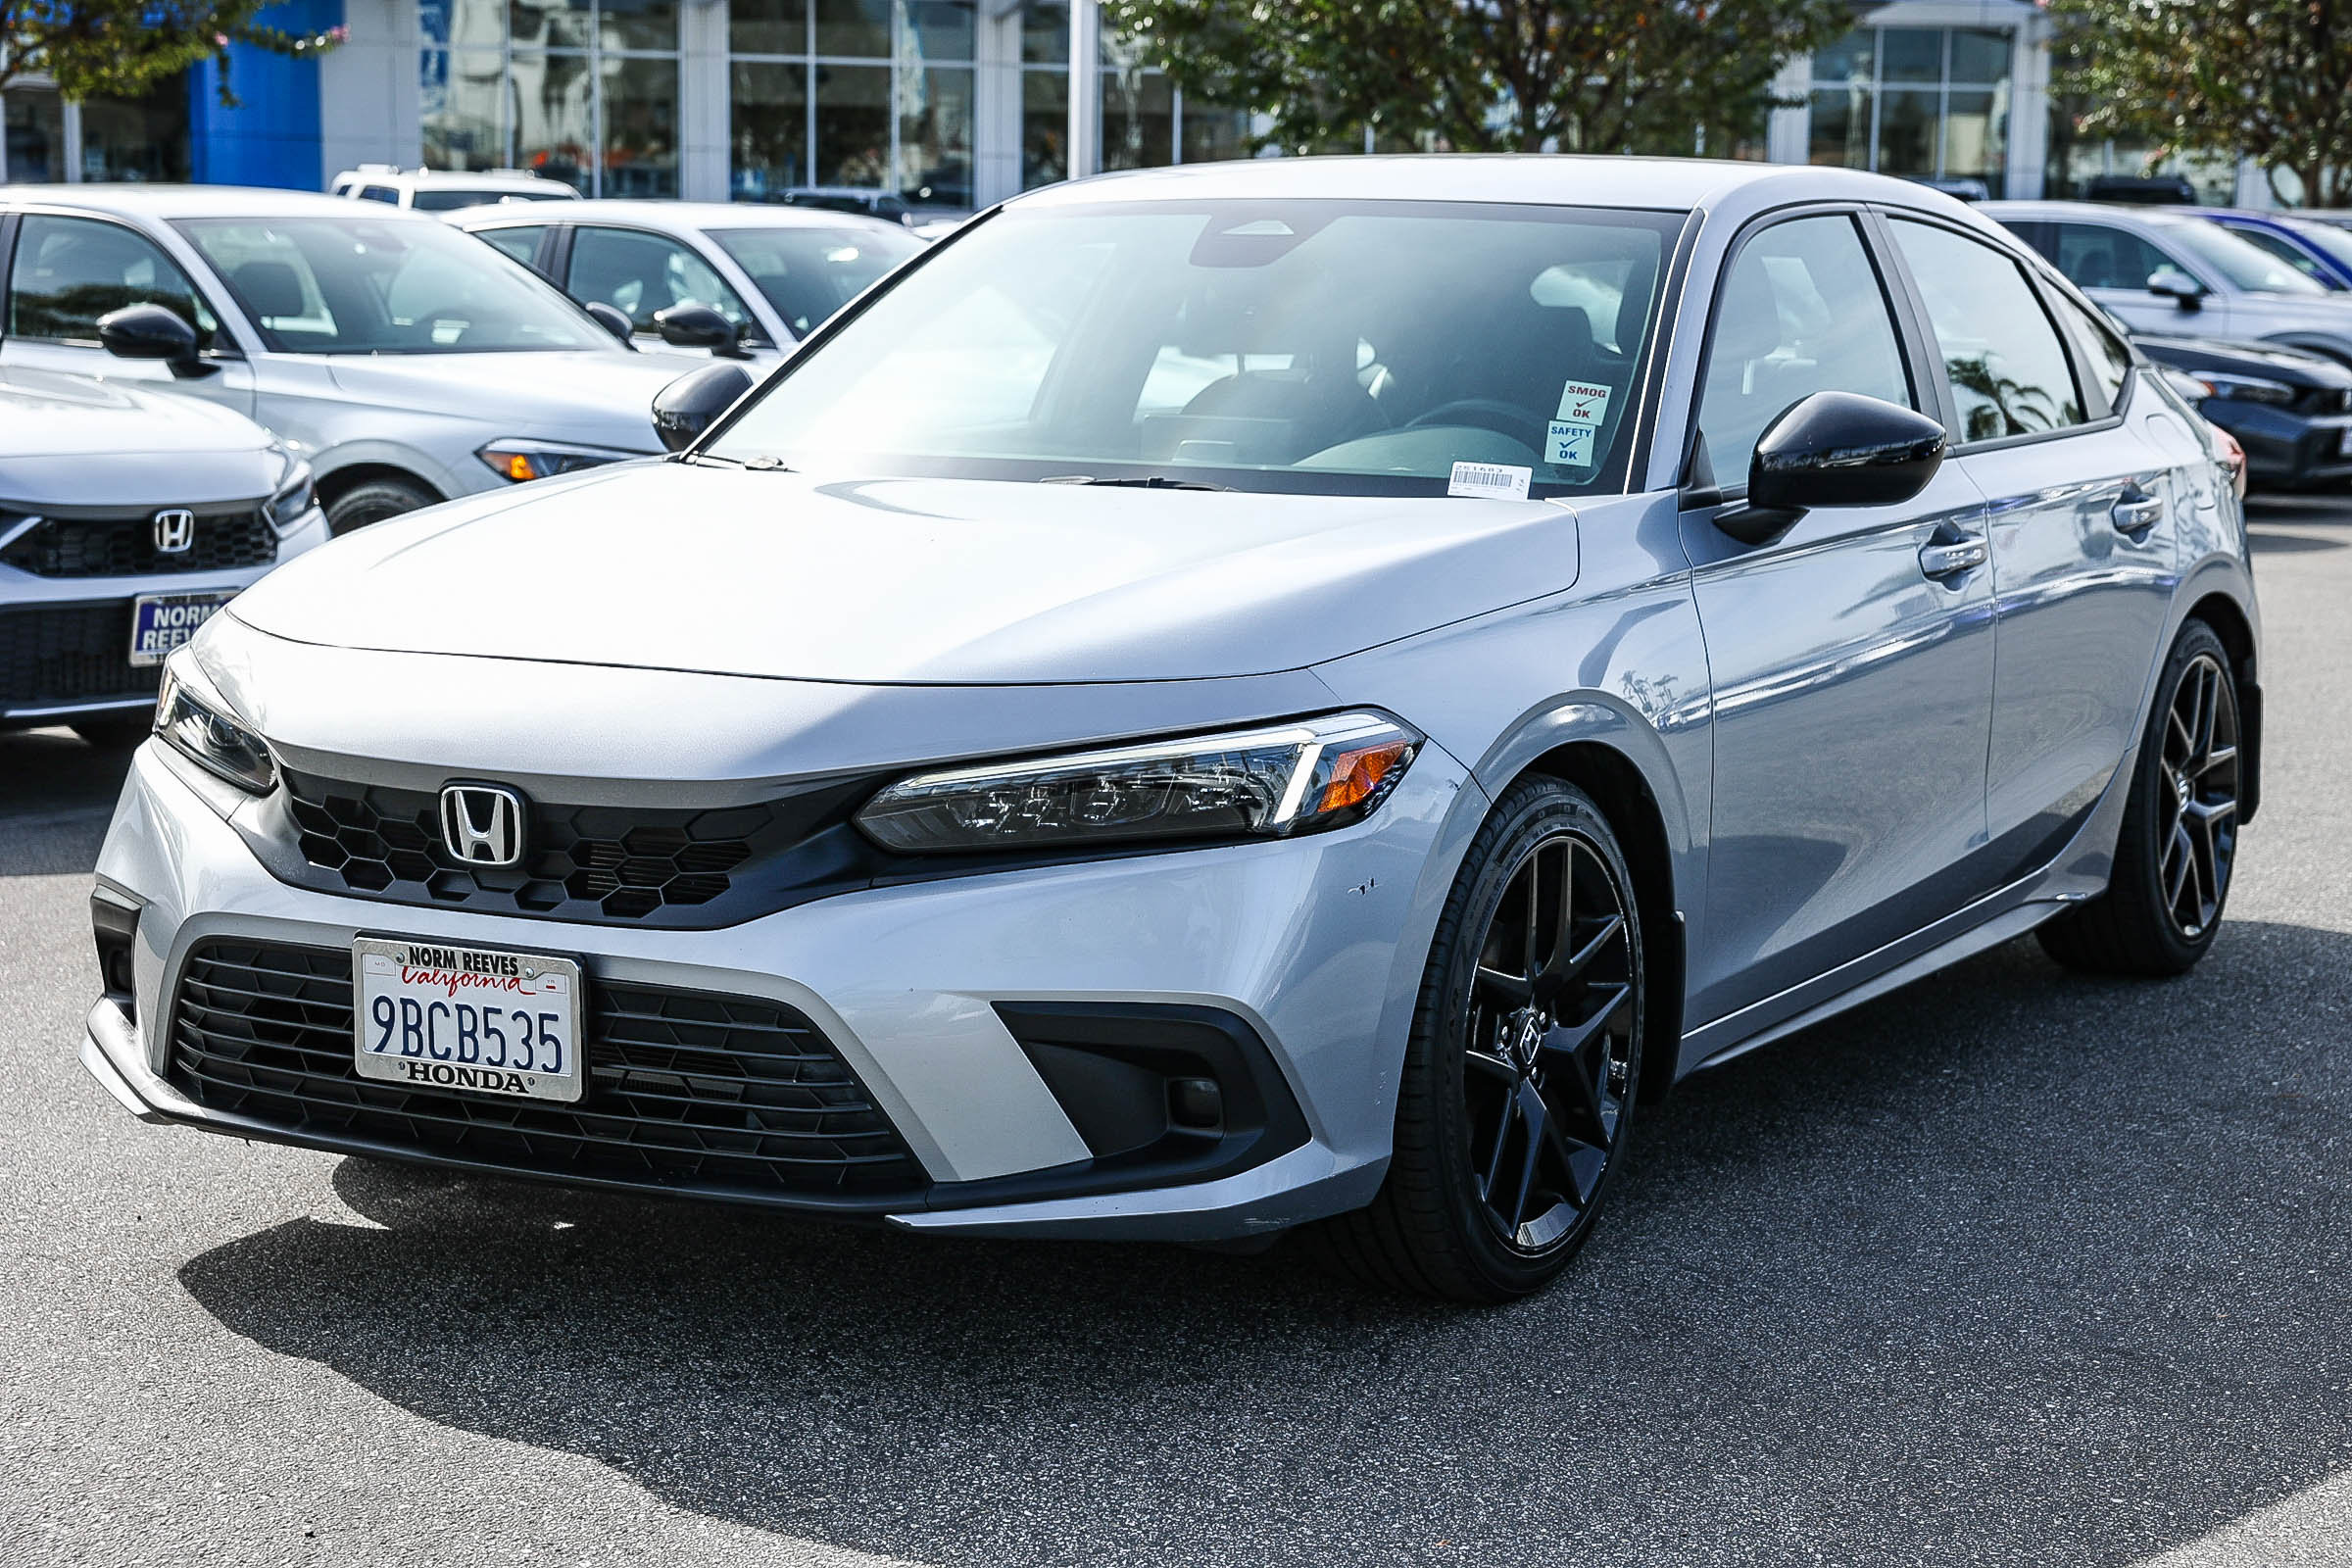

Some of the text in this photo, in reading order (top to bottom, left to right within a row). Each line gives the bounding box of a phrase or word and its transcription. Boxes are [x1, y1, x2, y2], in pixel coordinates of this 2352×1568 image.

[1568, 385, 1607, 398] SMOG
[1572, 408, 1592, 419] OK
[1550, 425, 1592, 439] SAFETY
[1559, 450, 1578, 461] OK
[142, 628, 197, 652] REEV
[409, 946, 519, 976] NORM REEVES
[401, 965, 536, 998] California
[371, 995, 563, 1074] 9BCB535
[407, 1060, 530, 1094] HONDA
